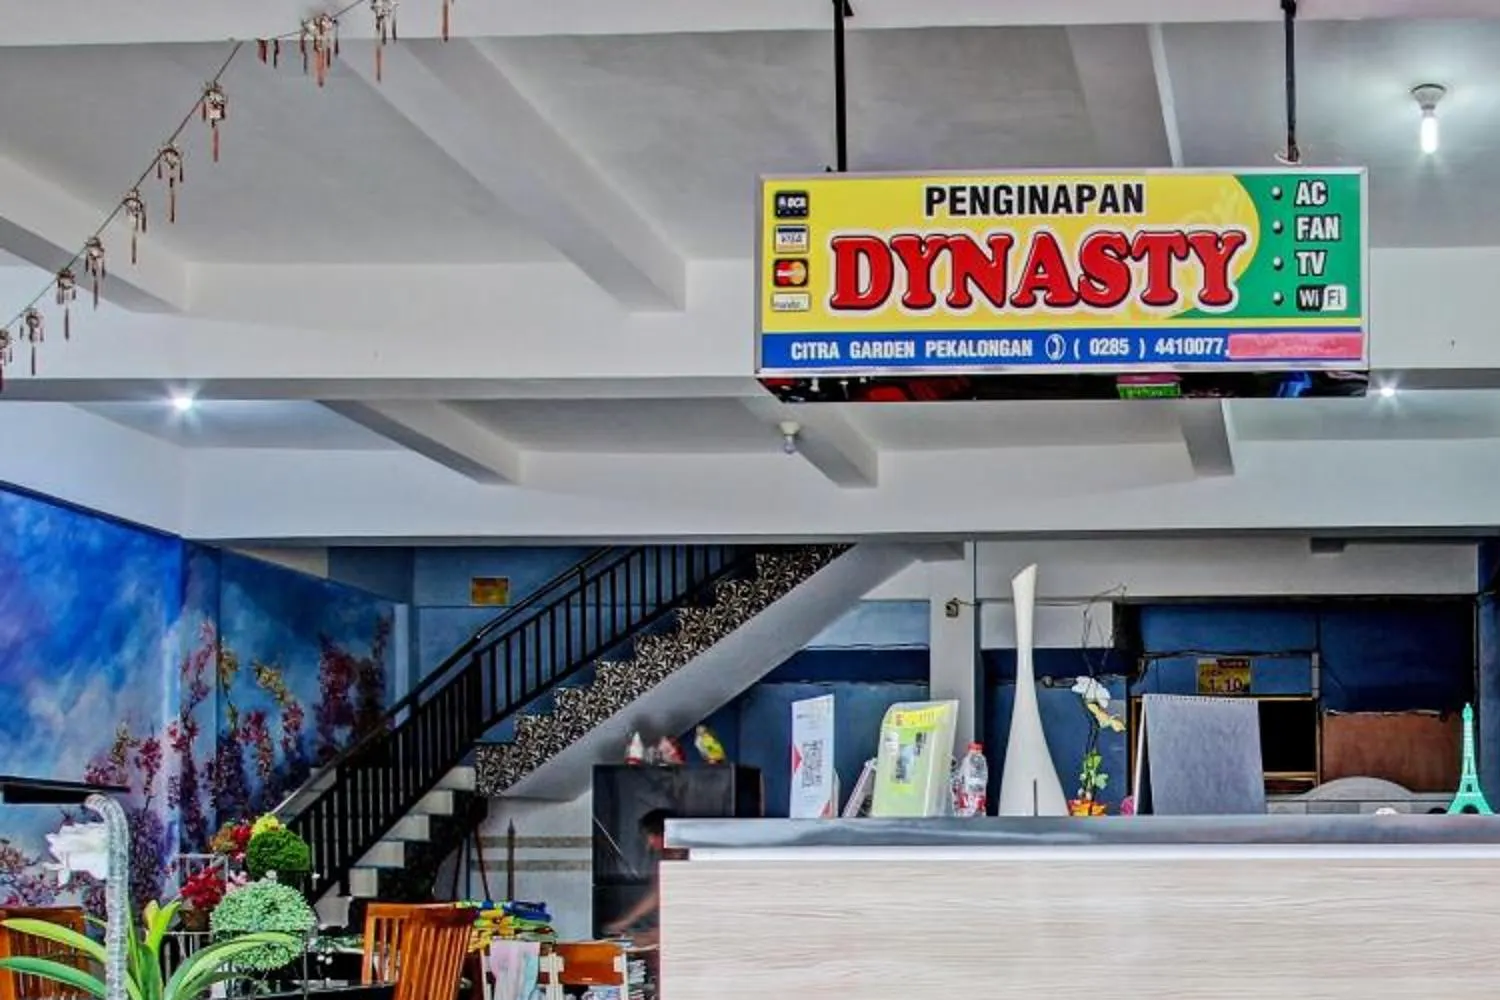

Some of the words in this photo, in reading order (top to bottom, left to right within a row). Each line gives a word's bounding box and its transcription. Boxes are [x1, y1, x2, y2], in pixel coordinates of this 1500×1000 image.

[926, 183, 1143, 217] PENGINAPAN
[1294, 181, 1328, 206] AC
[1296, 215, 1341, 241] FAN
[830, 231, 1247, 309] DYNASTY
[1295, 250, 1326, 275] TV
[791, 341, 841, 361] CITRA
[849, 340, 915, 360] GARDEN
[925, 338, 1033, 358] PEKALONGAN
[1089, 337, 1130, 356] 0285
